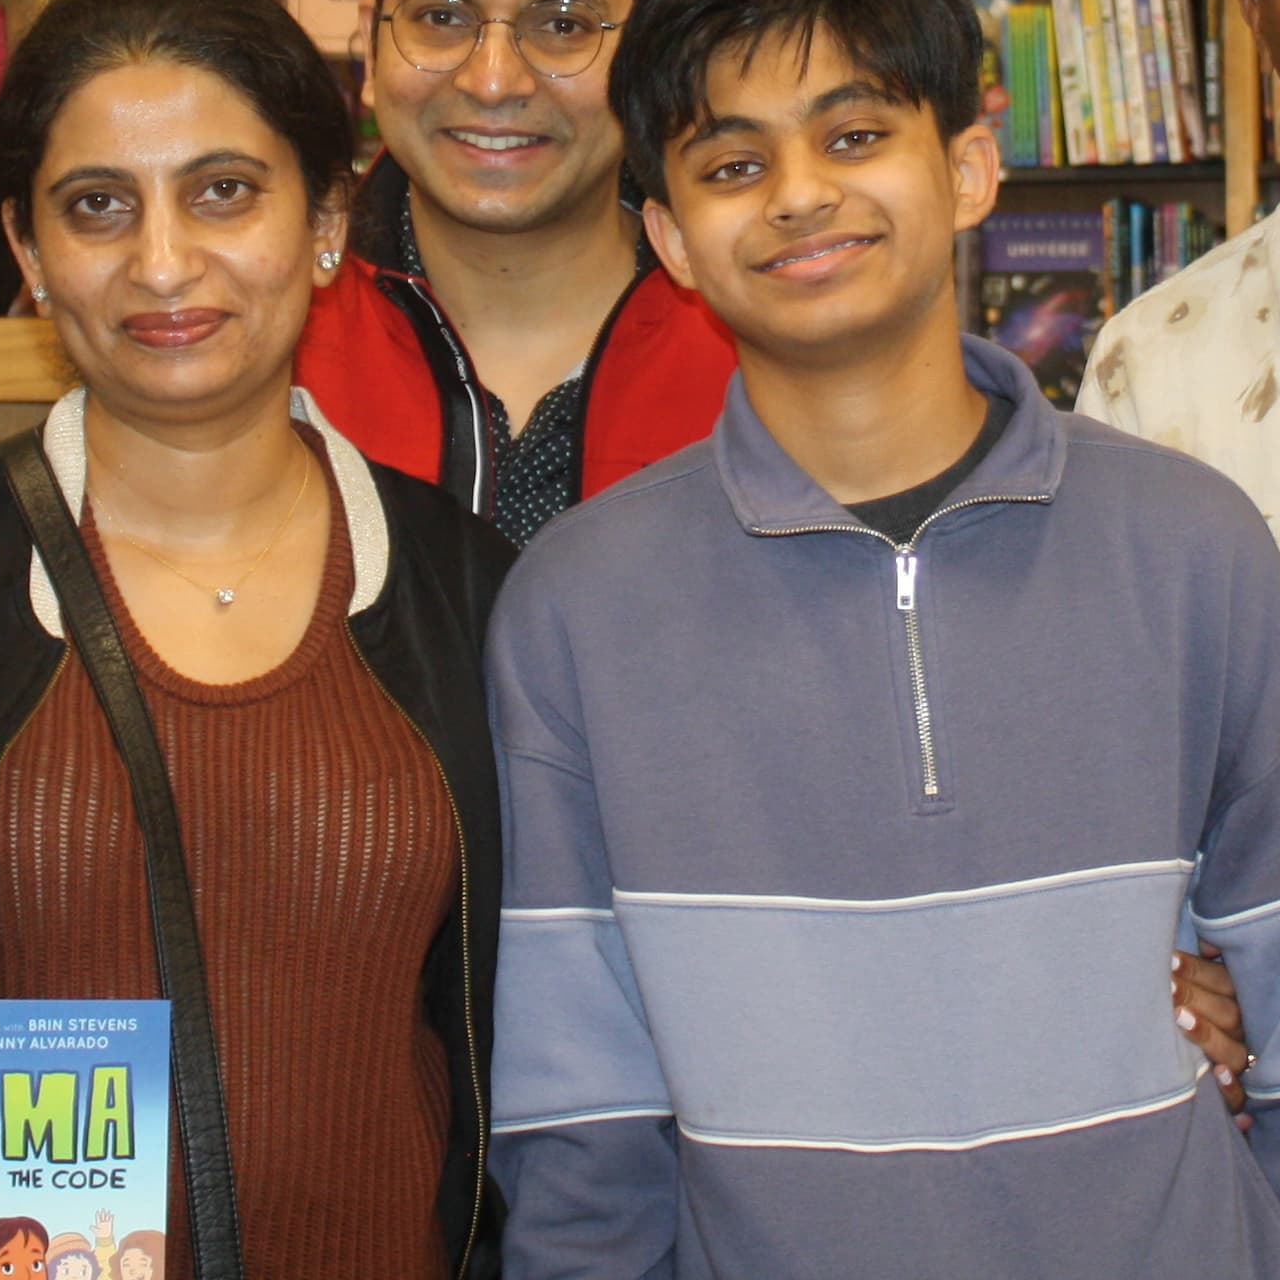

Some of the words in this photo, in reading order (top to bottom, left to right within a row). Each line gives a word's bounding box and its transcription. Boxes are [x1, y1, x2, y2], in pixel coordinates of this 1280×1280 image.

[1006, 241, 1090, 258] UNIVERSE
[28, 1018, 63, 1032] BRIN
[67, 1018, 138, 1031] STEVENS
[29, 1036, 109, 1050] ALVARADO
[7, 1169, 44, 1189] THE
[51, 1169, 127, 1190] CODE
